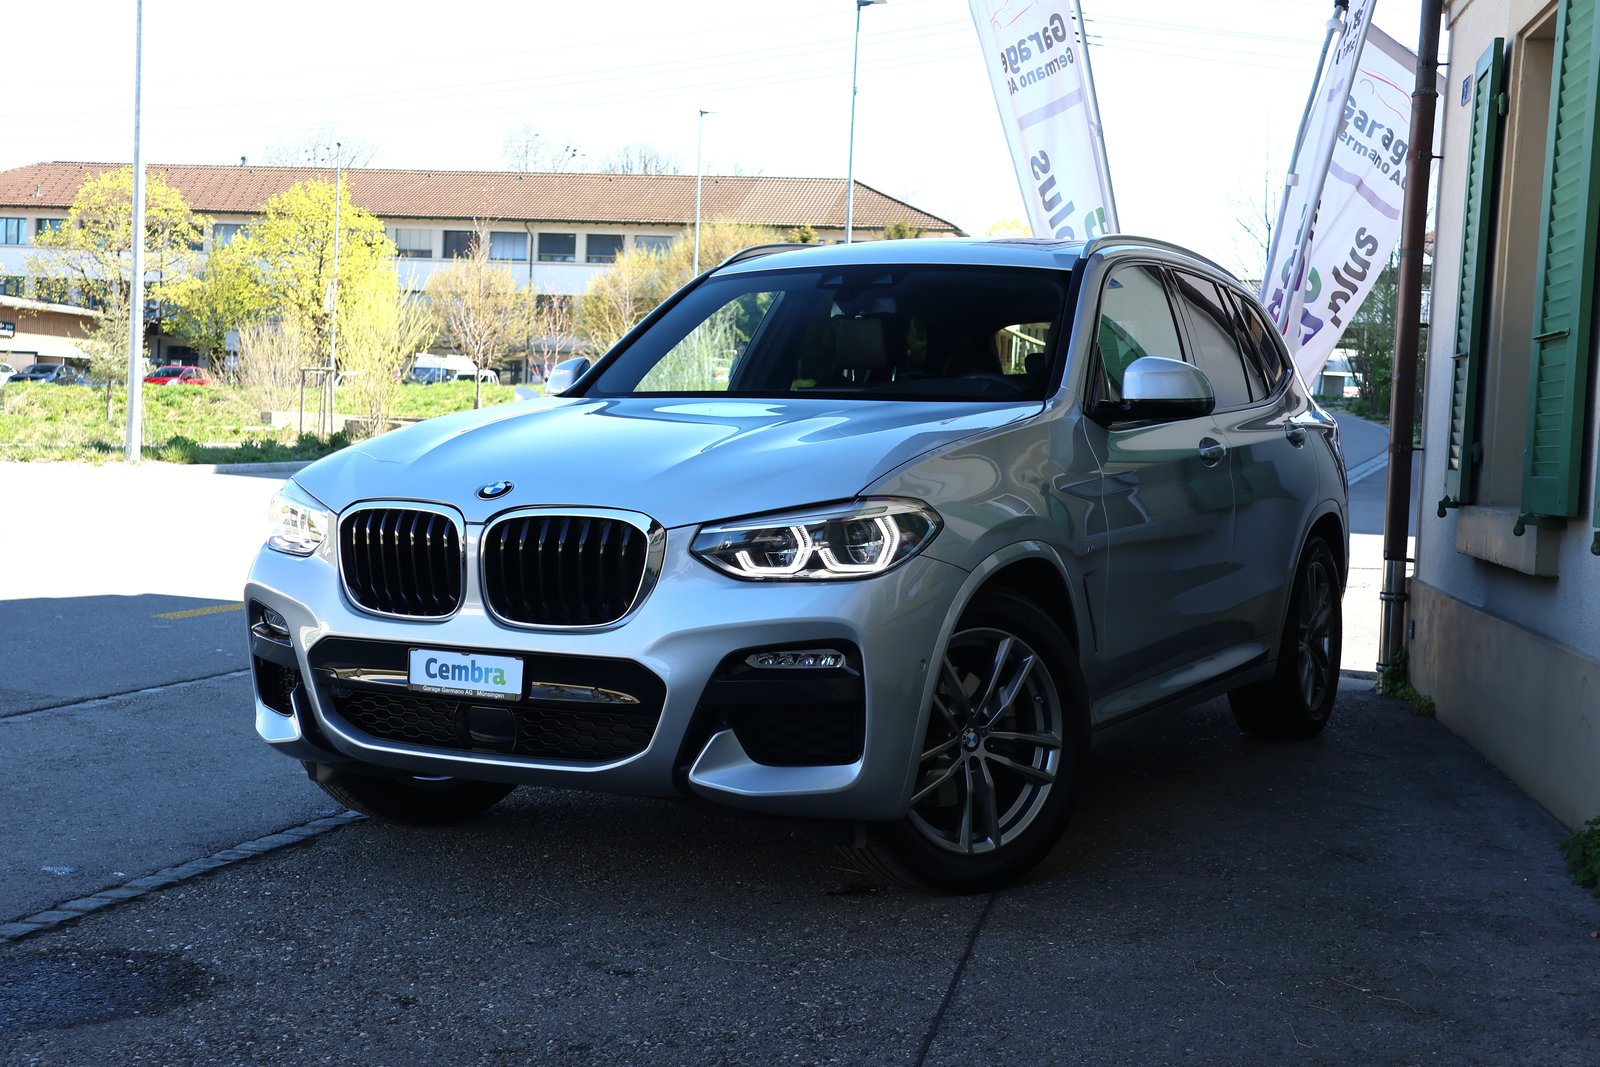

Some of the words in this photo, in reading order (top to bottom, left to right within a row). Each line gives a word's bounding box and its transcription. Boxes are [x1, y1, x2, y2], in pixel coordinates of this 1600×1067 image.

[1343, 95, 1408, 165] Garag
[1338, 131, 1390, 174] ermano
[425, 657, 506, 685] Cembra
[422, 685, 441, 693] Garage
[441, 687, 464, 695] Germano
[476, 690, 505, 699] Münsingen
